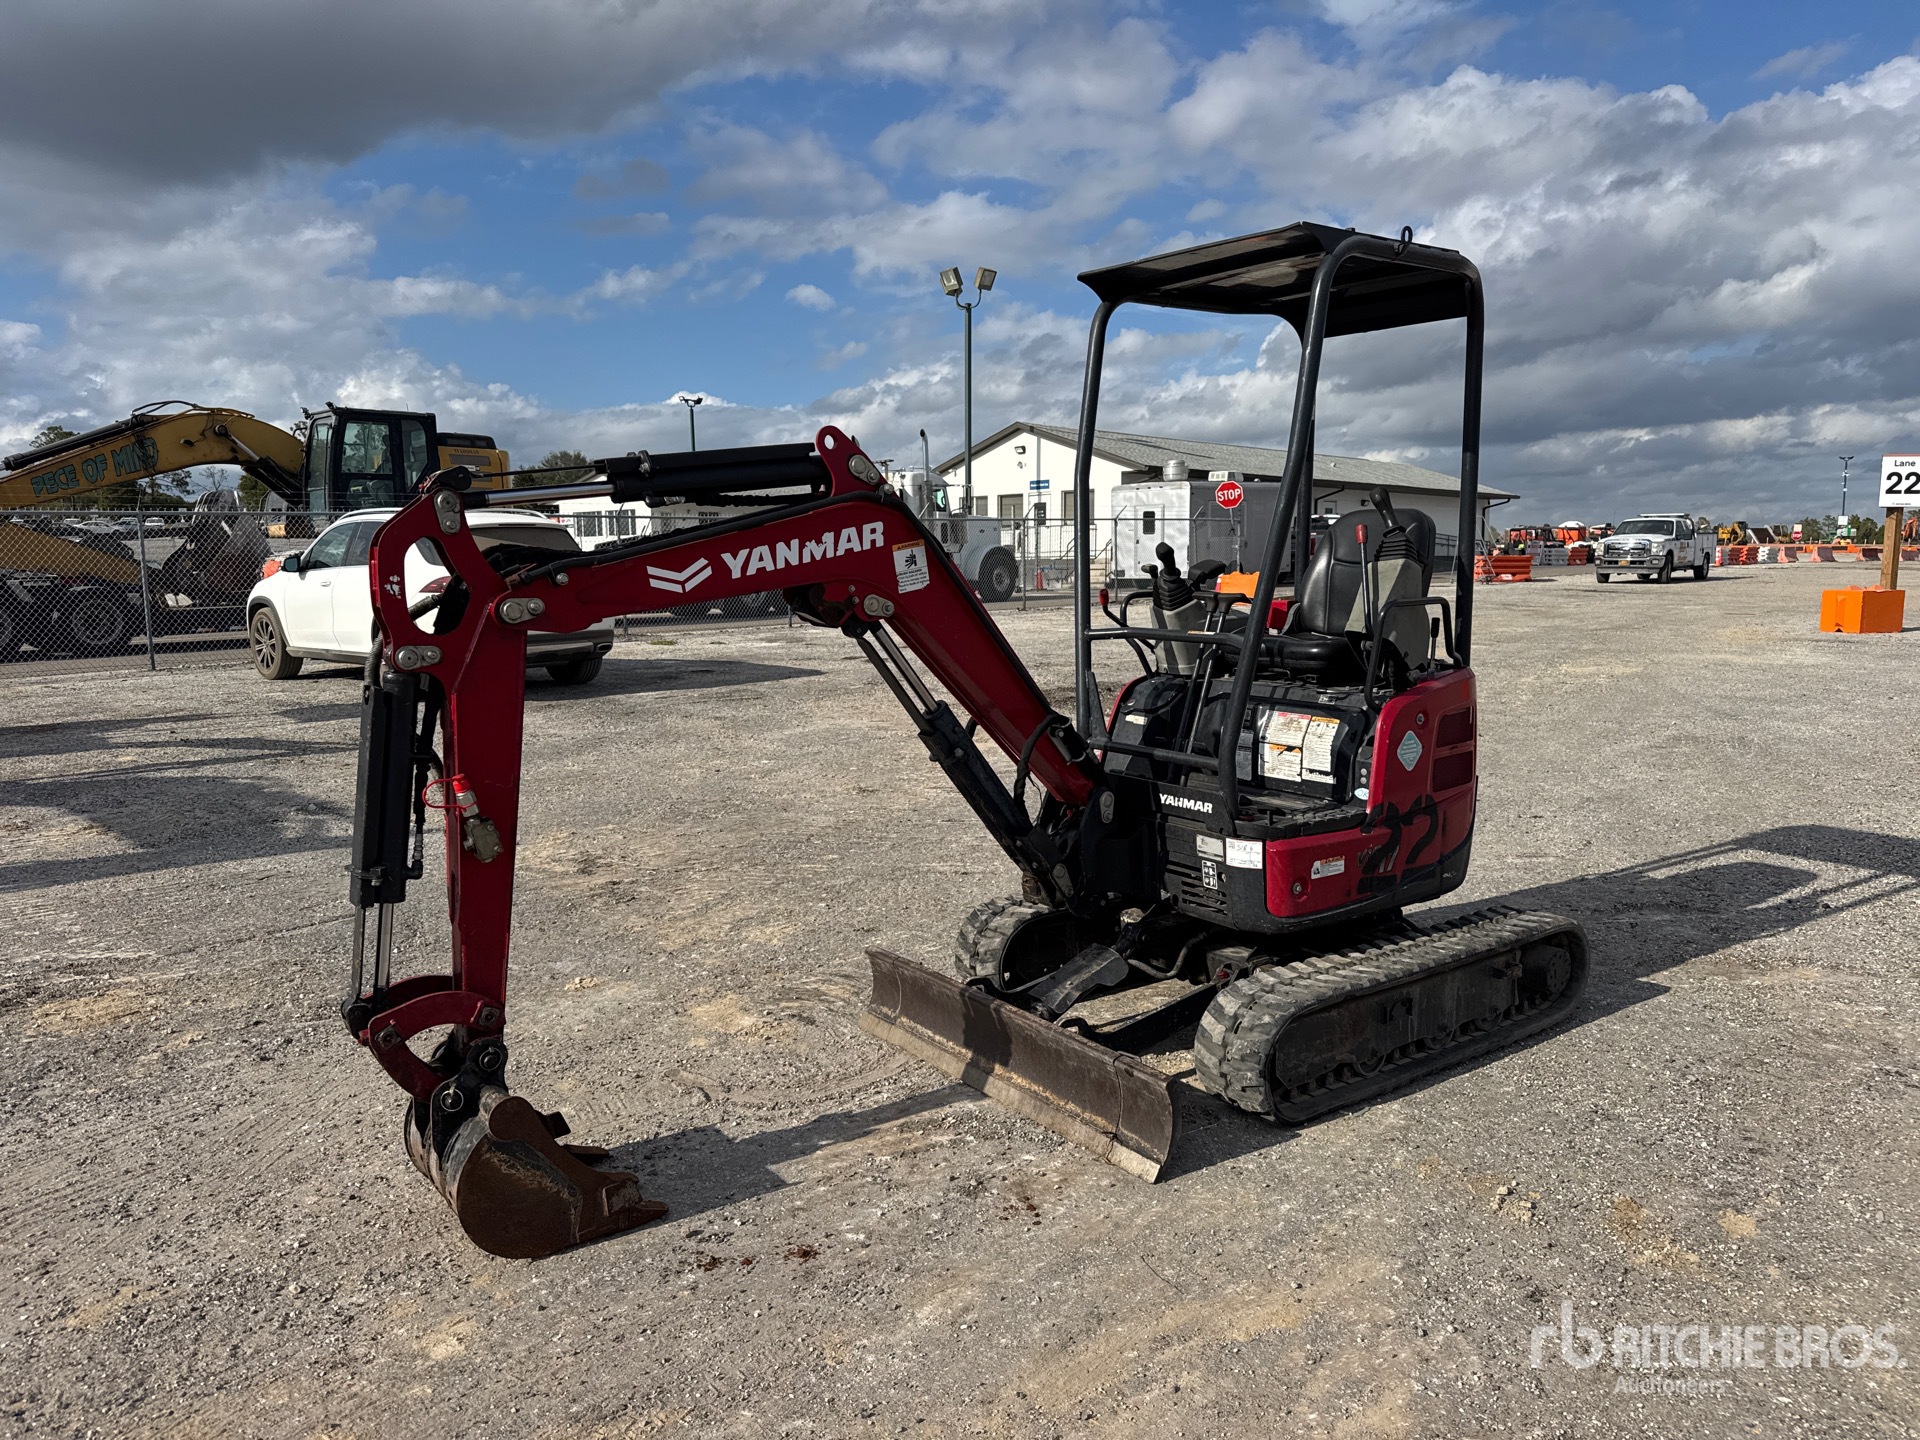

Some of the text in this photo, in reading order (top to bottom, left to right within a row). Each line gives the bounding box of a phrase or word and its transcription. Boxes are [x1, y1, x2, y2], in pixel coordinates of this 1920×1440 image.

[31, 464, 79, 497] PECE
[82, 453, 108, 484] OF
[1885, 471, 1920, 494] 22
[1217, 488, 1241, 501] STOP
[720, 521, 884, 579] YANMAR
[1159, 793, 1213, 814] YANMAR
